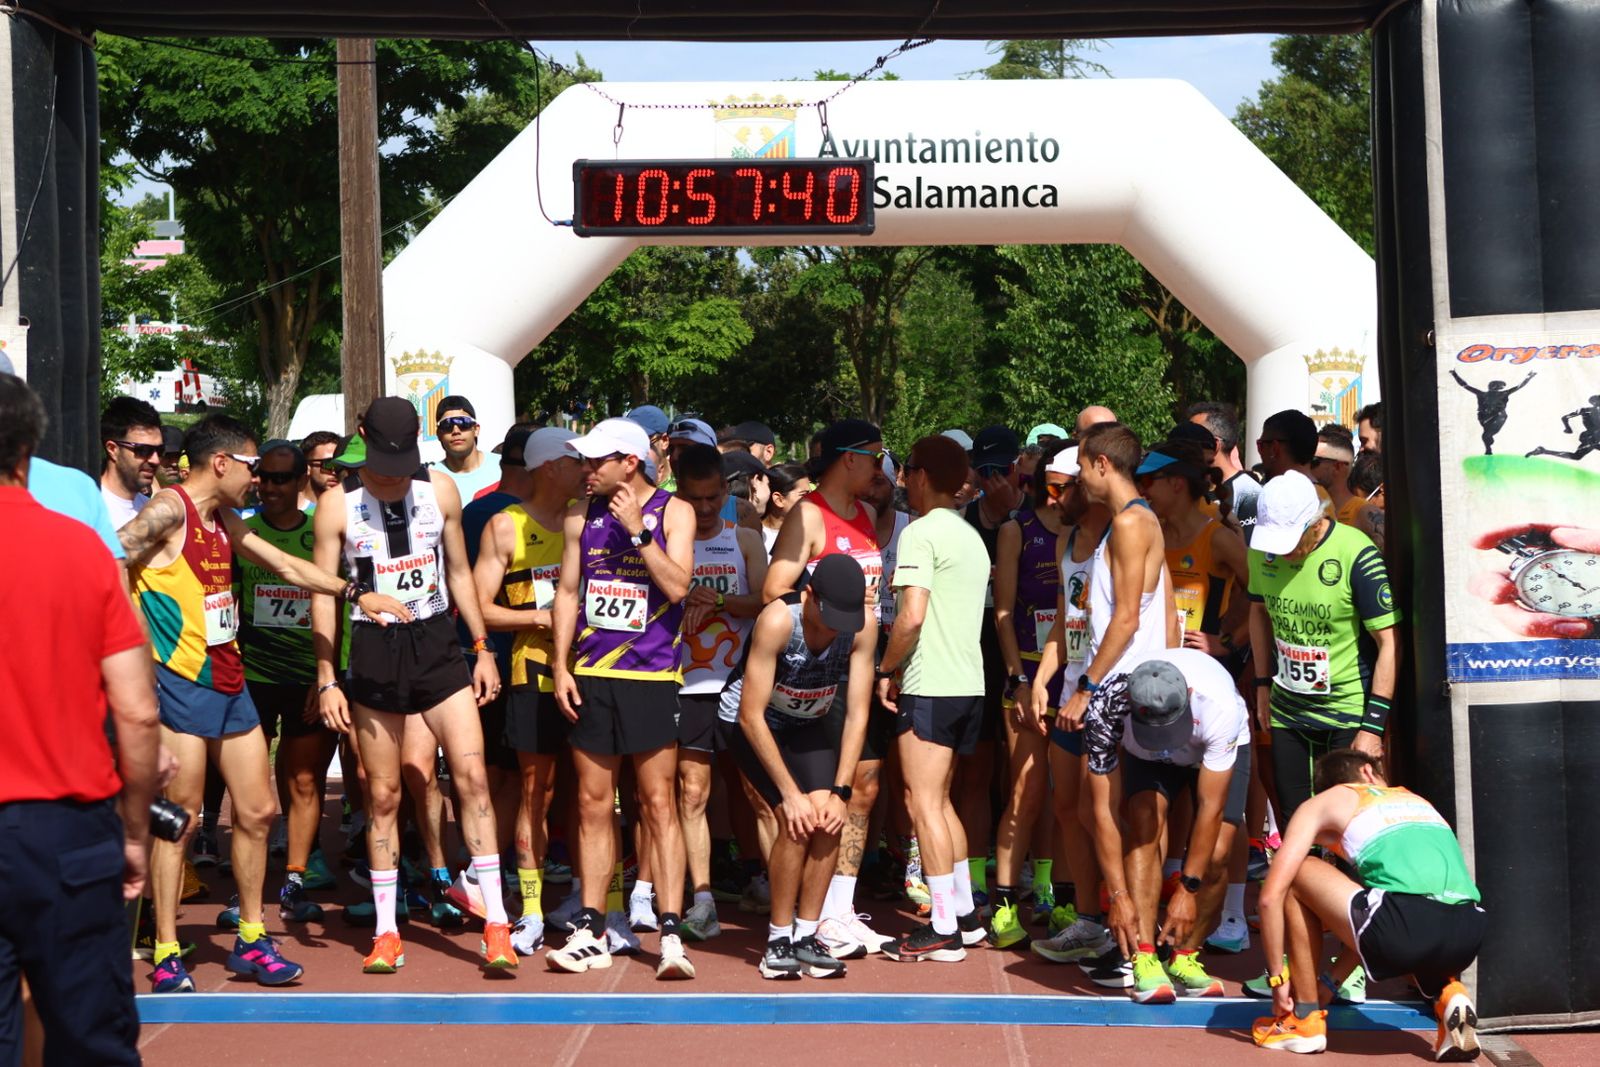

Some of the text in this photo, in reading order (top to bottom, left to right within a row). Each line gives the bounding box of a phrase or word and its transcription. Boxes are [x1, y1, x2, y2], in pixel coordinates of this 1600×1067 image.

[818, 129, 1060, 163] Ayuntamiento
[873, 175, 1058, 208] Salamanca
[397, 569, 424, 591] 48
[270, 599, 296, 618] 74
[594, 597, 636, 619] 267
[1264, 594, 1332, 620] ORRECAMINOS
[1272, 614, 1332, 638] ARBAJOSA
[1283, 657, 1317, 682] 155
[787, 698, 818, 711] 37
